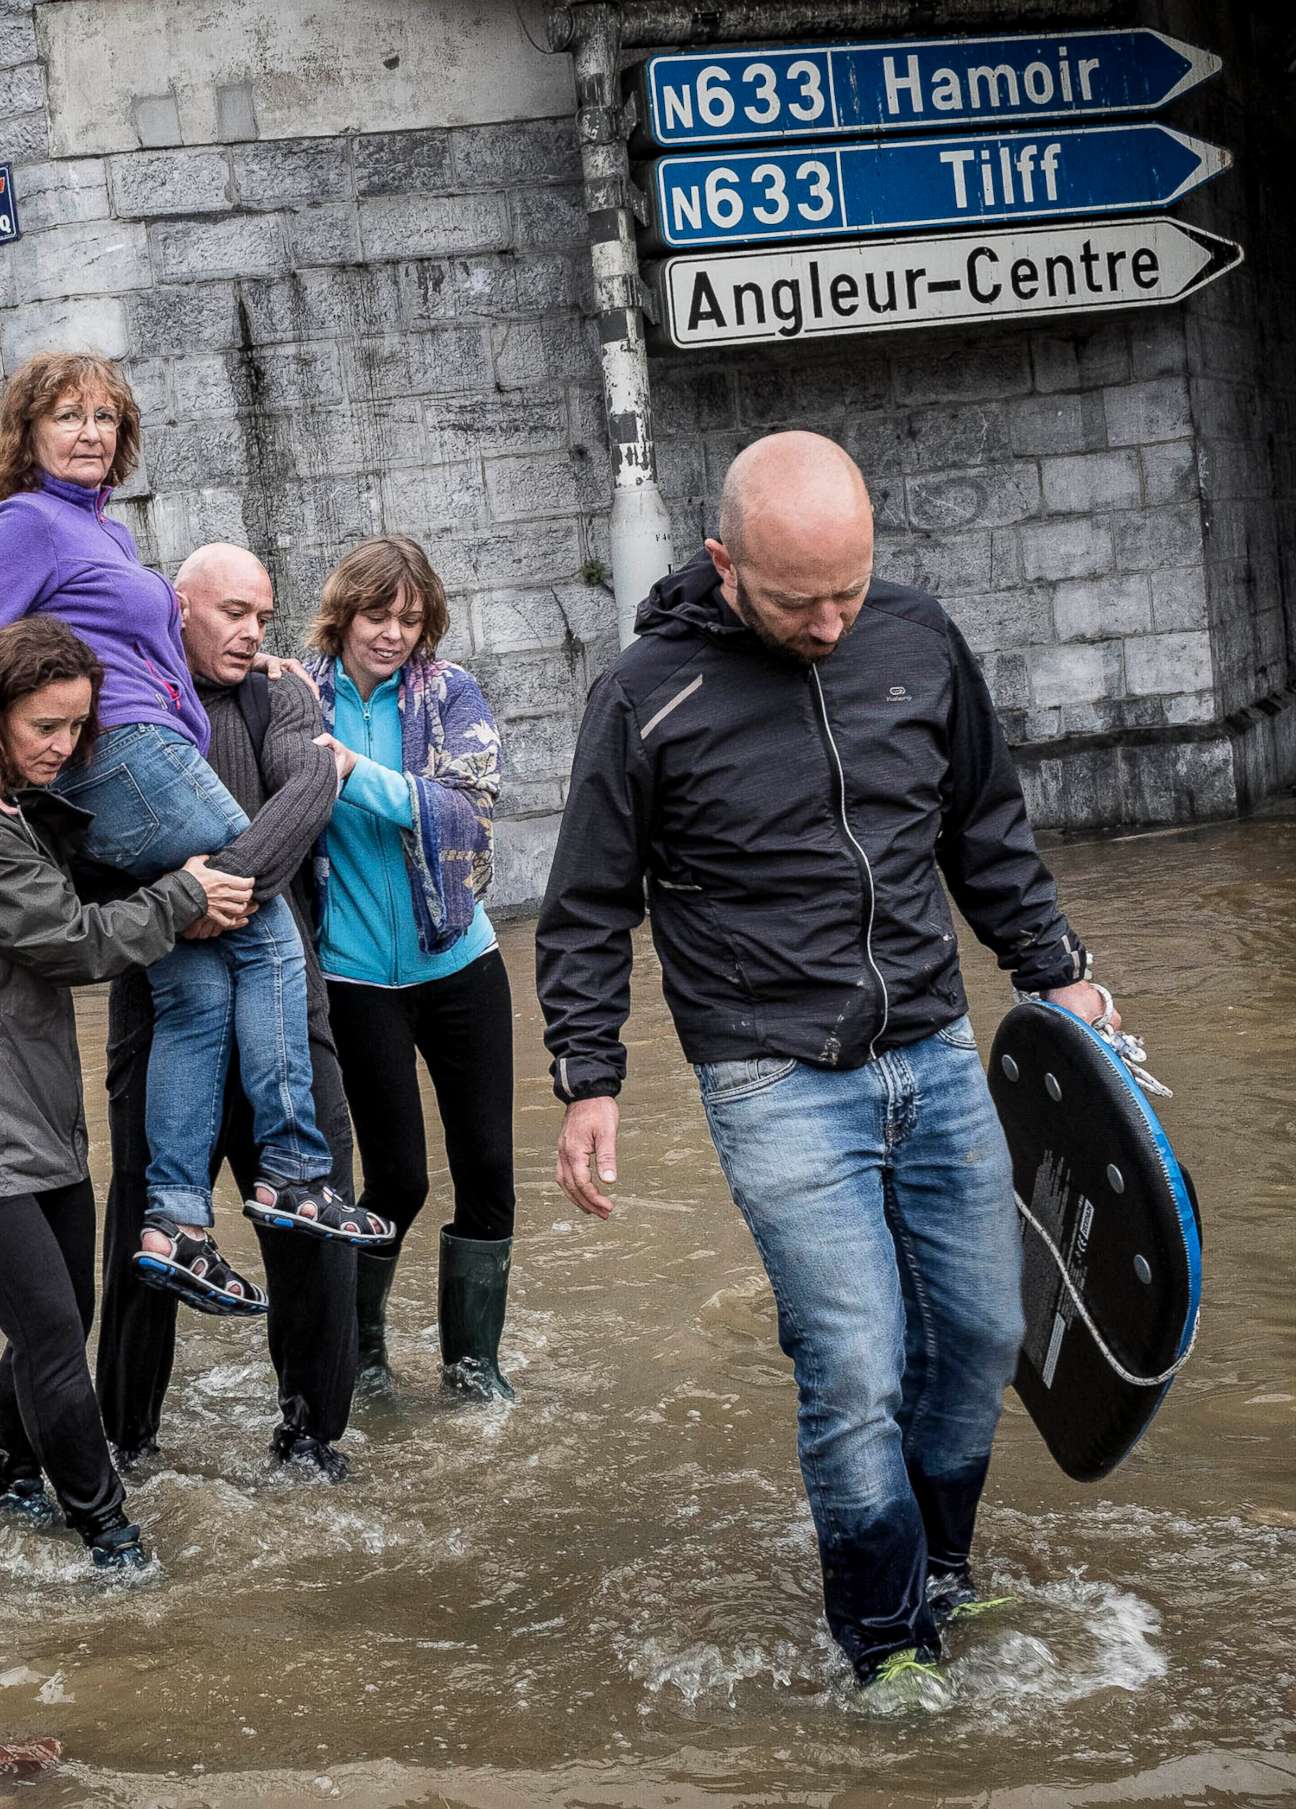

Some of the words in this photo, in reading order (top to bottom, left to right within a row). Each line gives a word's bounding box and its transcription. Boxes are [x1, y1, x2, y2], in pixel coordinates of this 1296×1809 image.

[663, 60, 826, 130] N633
[883, 46, 1099, 115] Hamoir
[671, 161, 834, 230] N633
[940, 143, 1062, 209] Tilff
[687, 240, 1159, 336] Angleur-Centre
